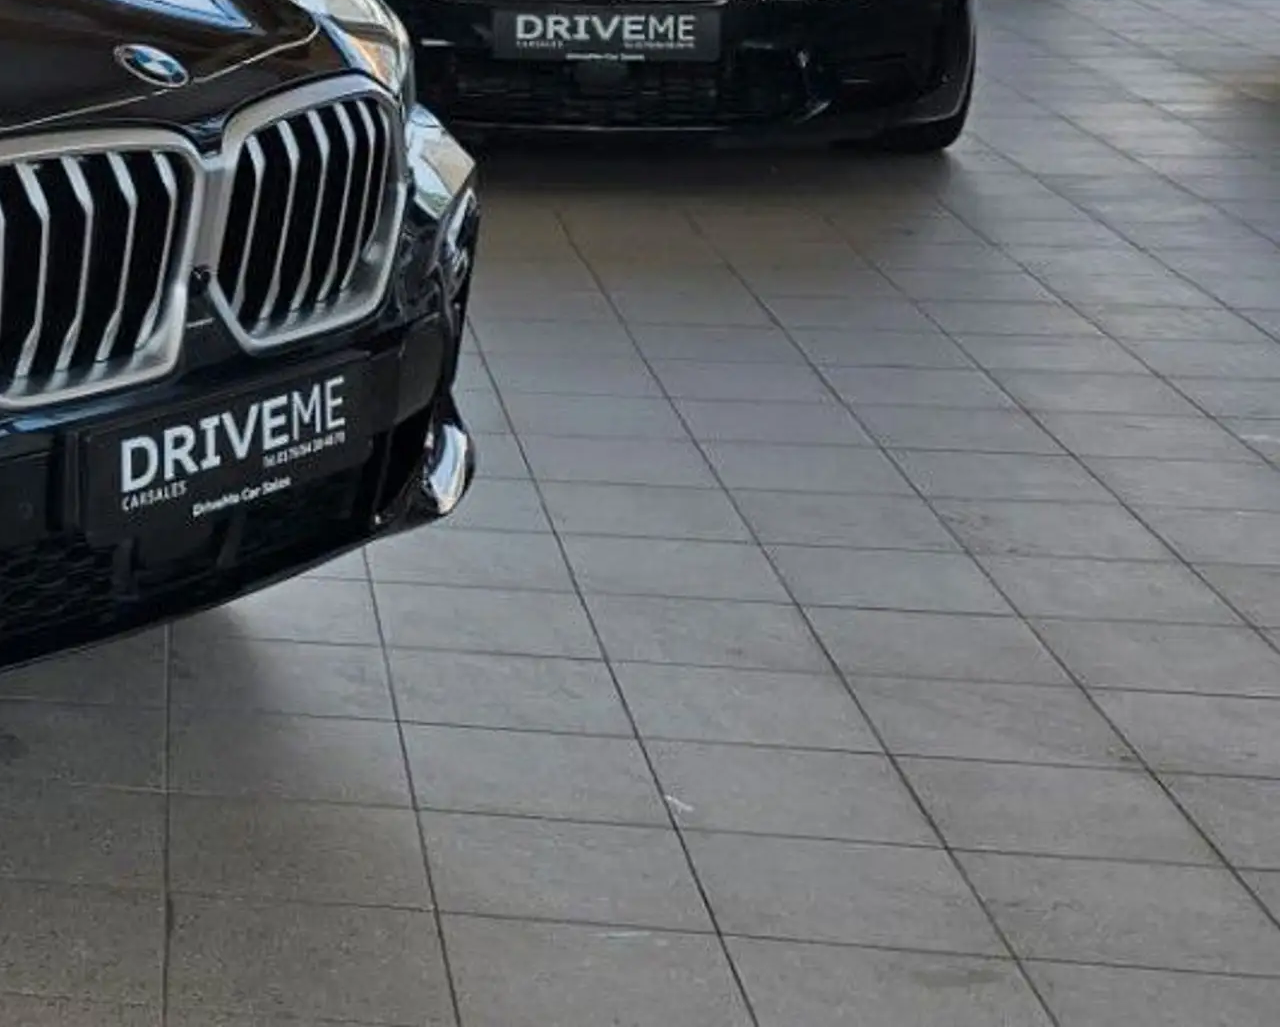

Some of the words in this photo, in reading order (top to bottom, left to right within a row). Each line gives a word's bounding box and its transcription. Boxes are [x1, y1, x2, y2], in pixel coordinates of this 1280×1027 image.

[515, 13, 696, 41] DRIVEME
[120, 375, 346, 493] DRIVEME
[121, 479, 188, 511] CARSALES
